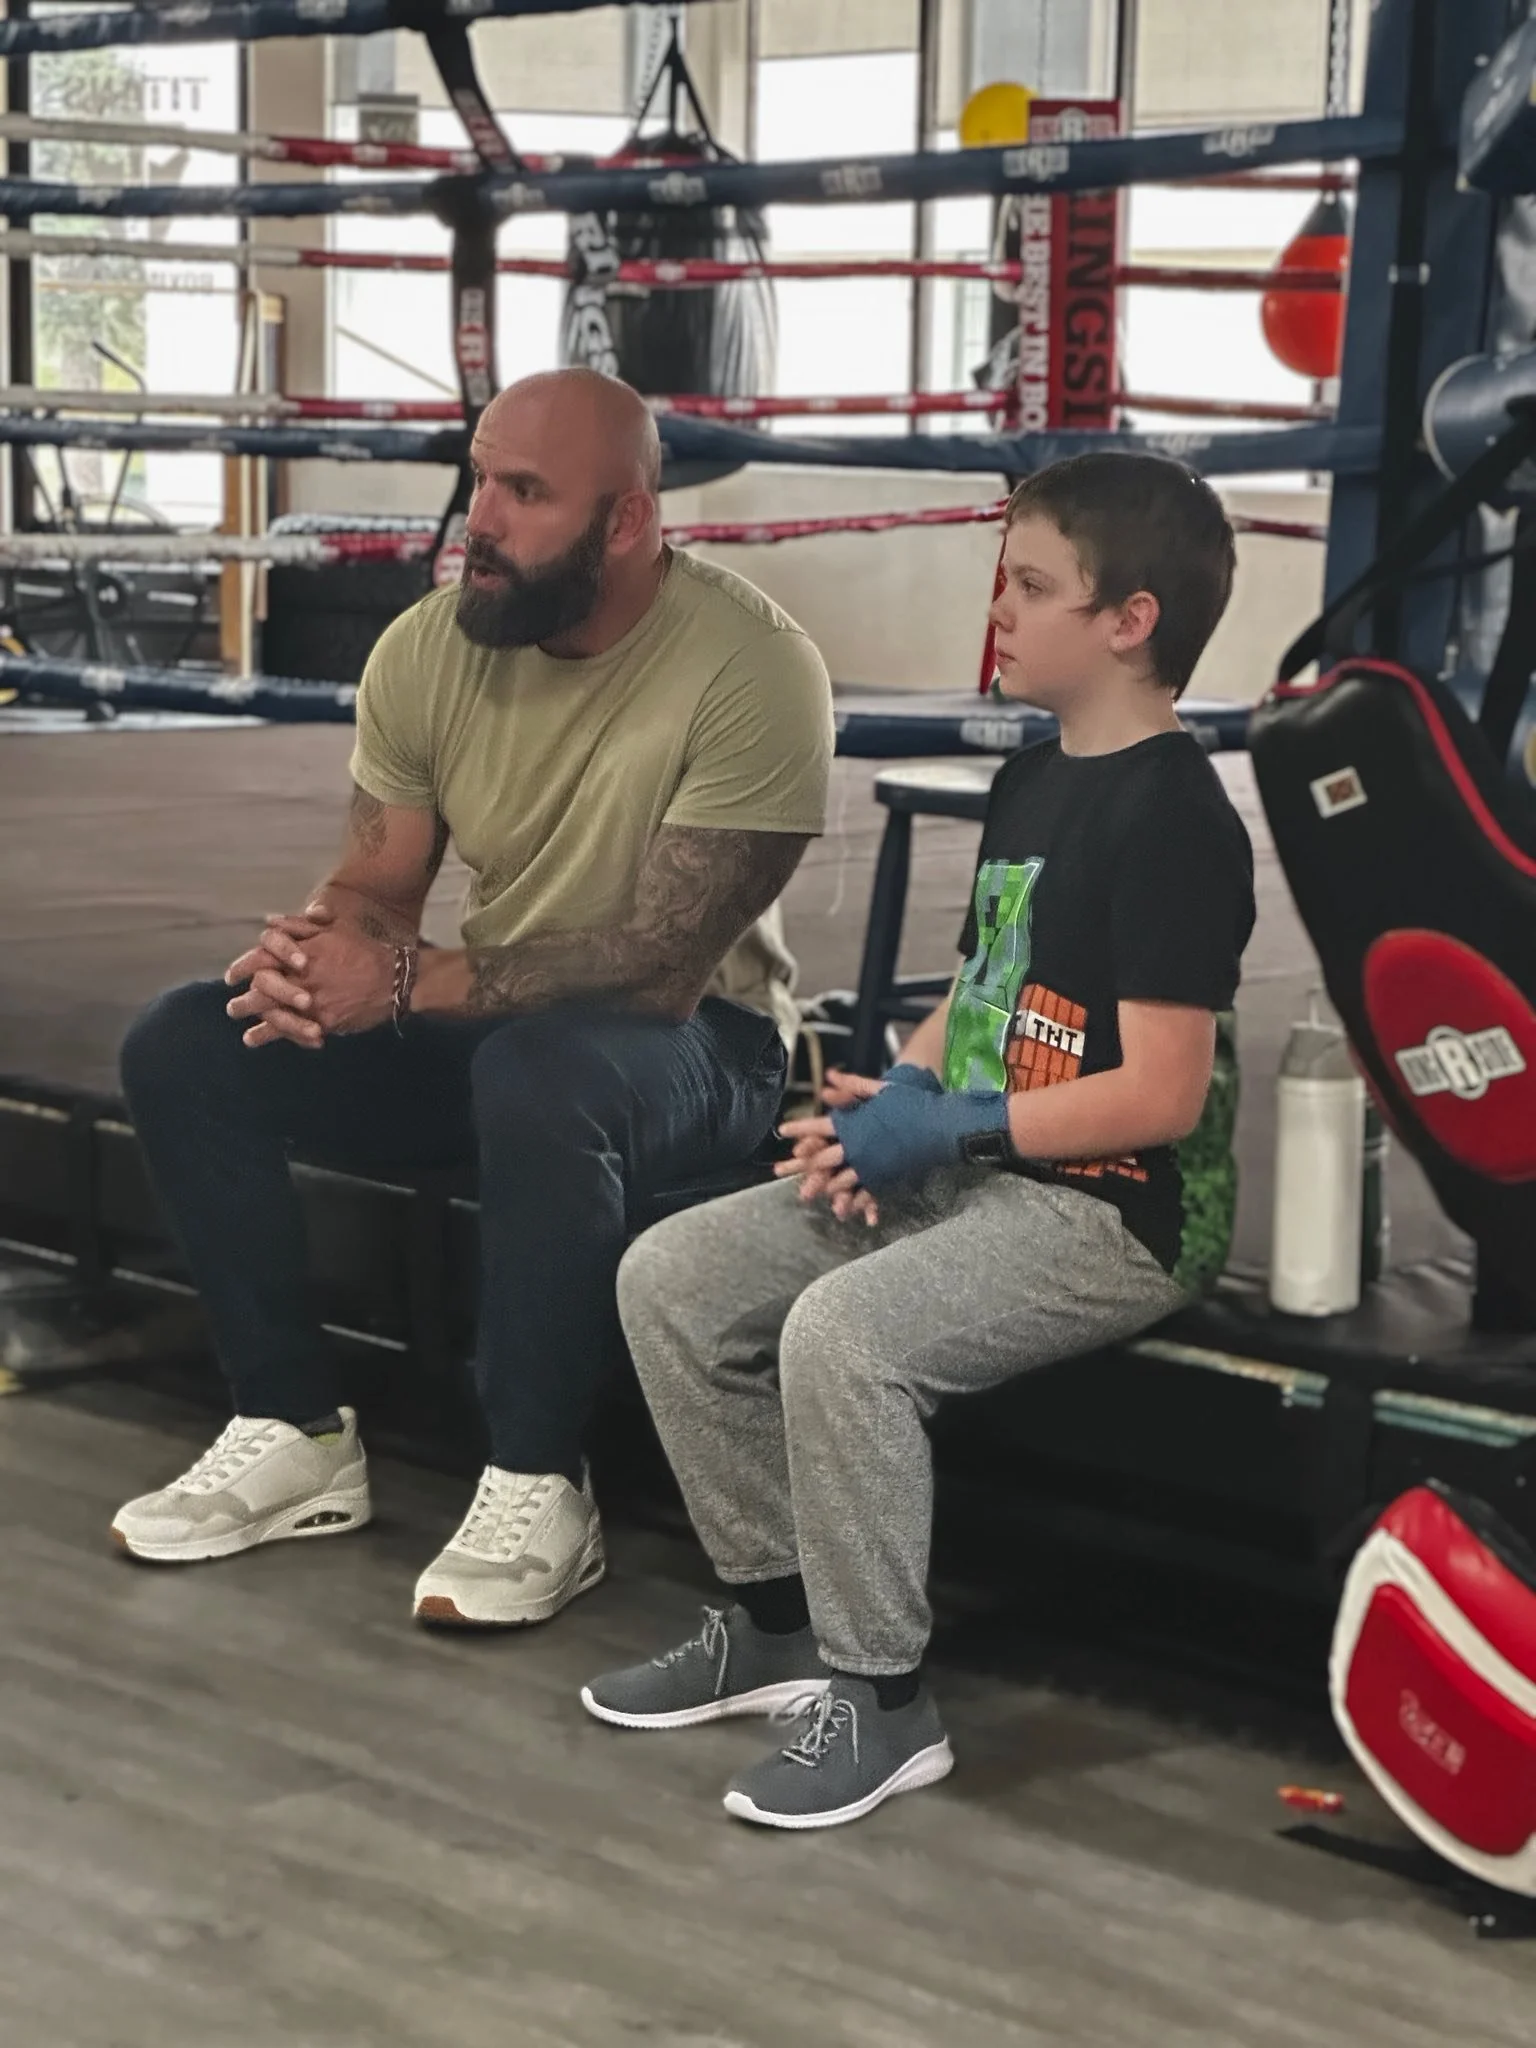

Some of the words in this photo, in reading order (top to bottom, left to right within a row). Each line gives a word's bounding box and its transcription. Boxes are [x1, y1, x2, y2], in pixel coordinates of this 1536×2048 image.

[1021, 242, 1051, 330] BEST
[1065, 187, 1114, 432] INGSI
[1020, 335, 1049, 373] IN
[1033, 1018, 1077, 1052] TNT
